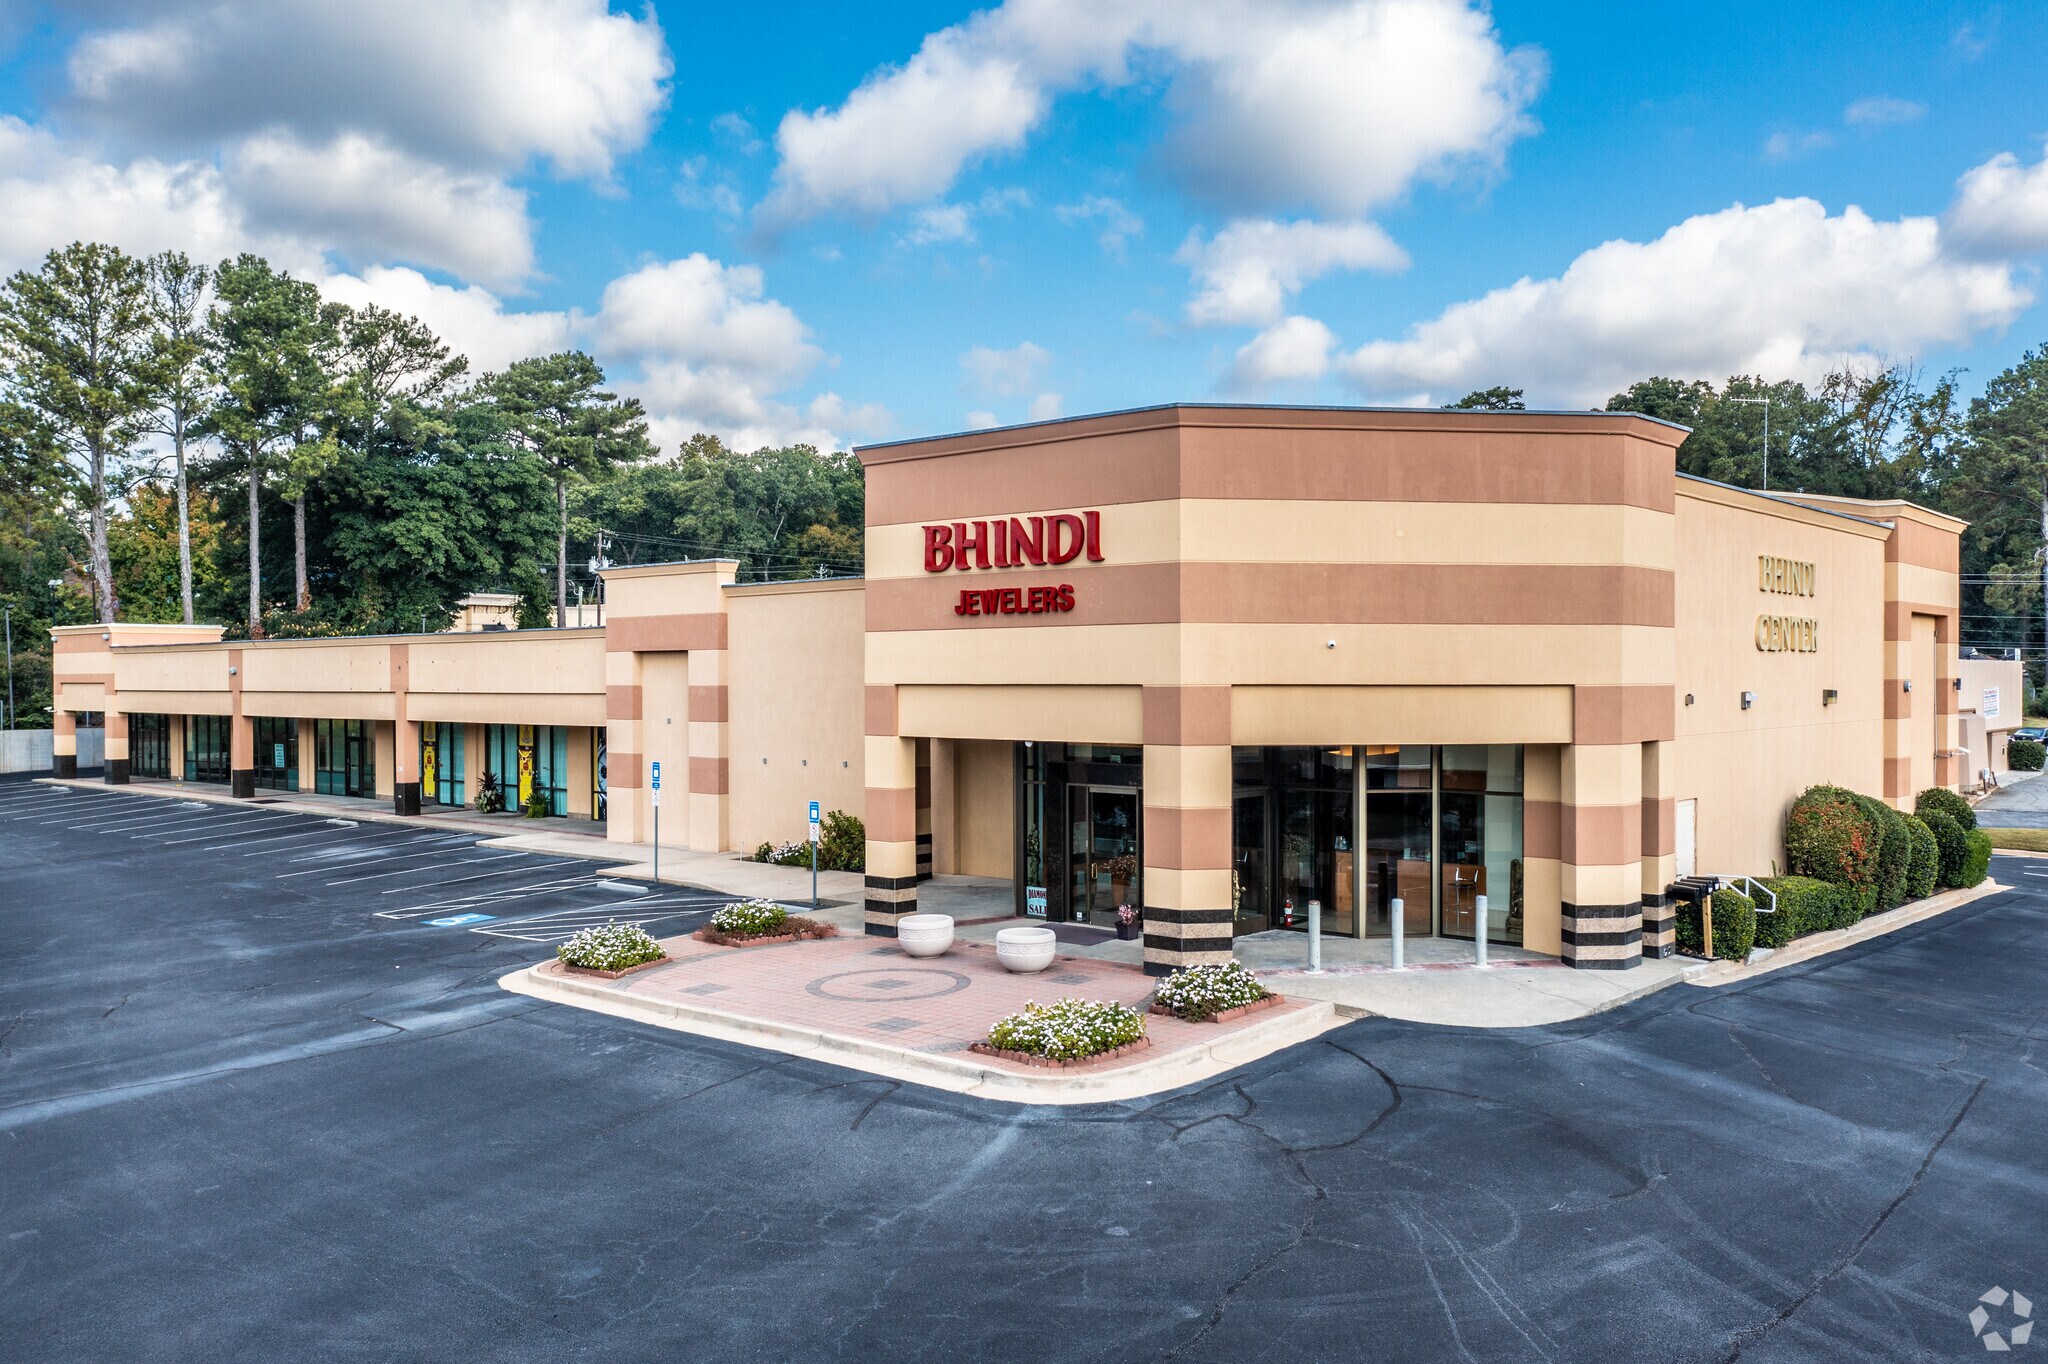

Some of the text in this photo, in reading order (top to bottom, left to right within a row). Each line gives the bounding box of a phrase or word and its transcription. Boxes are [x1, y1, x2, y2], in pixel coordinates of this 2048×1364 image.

[922, 511, 1105, 572] BHINDI
[1758, 554, 1816, 597] BHINDI
[954, 584, 1075, 615] JEWELERS
[1755, 614, 1818, 652] CENTER
